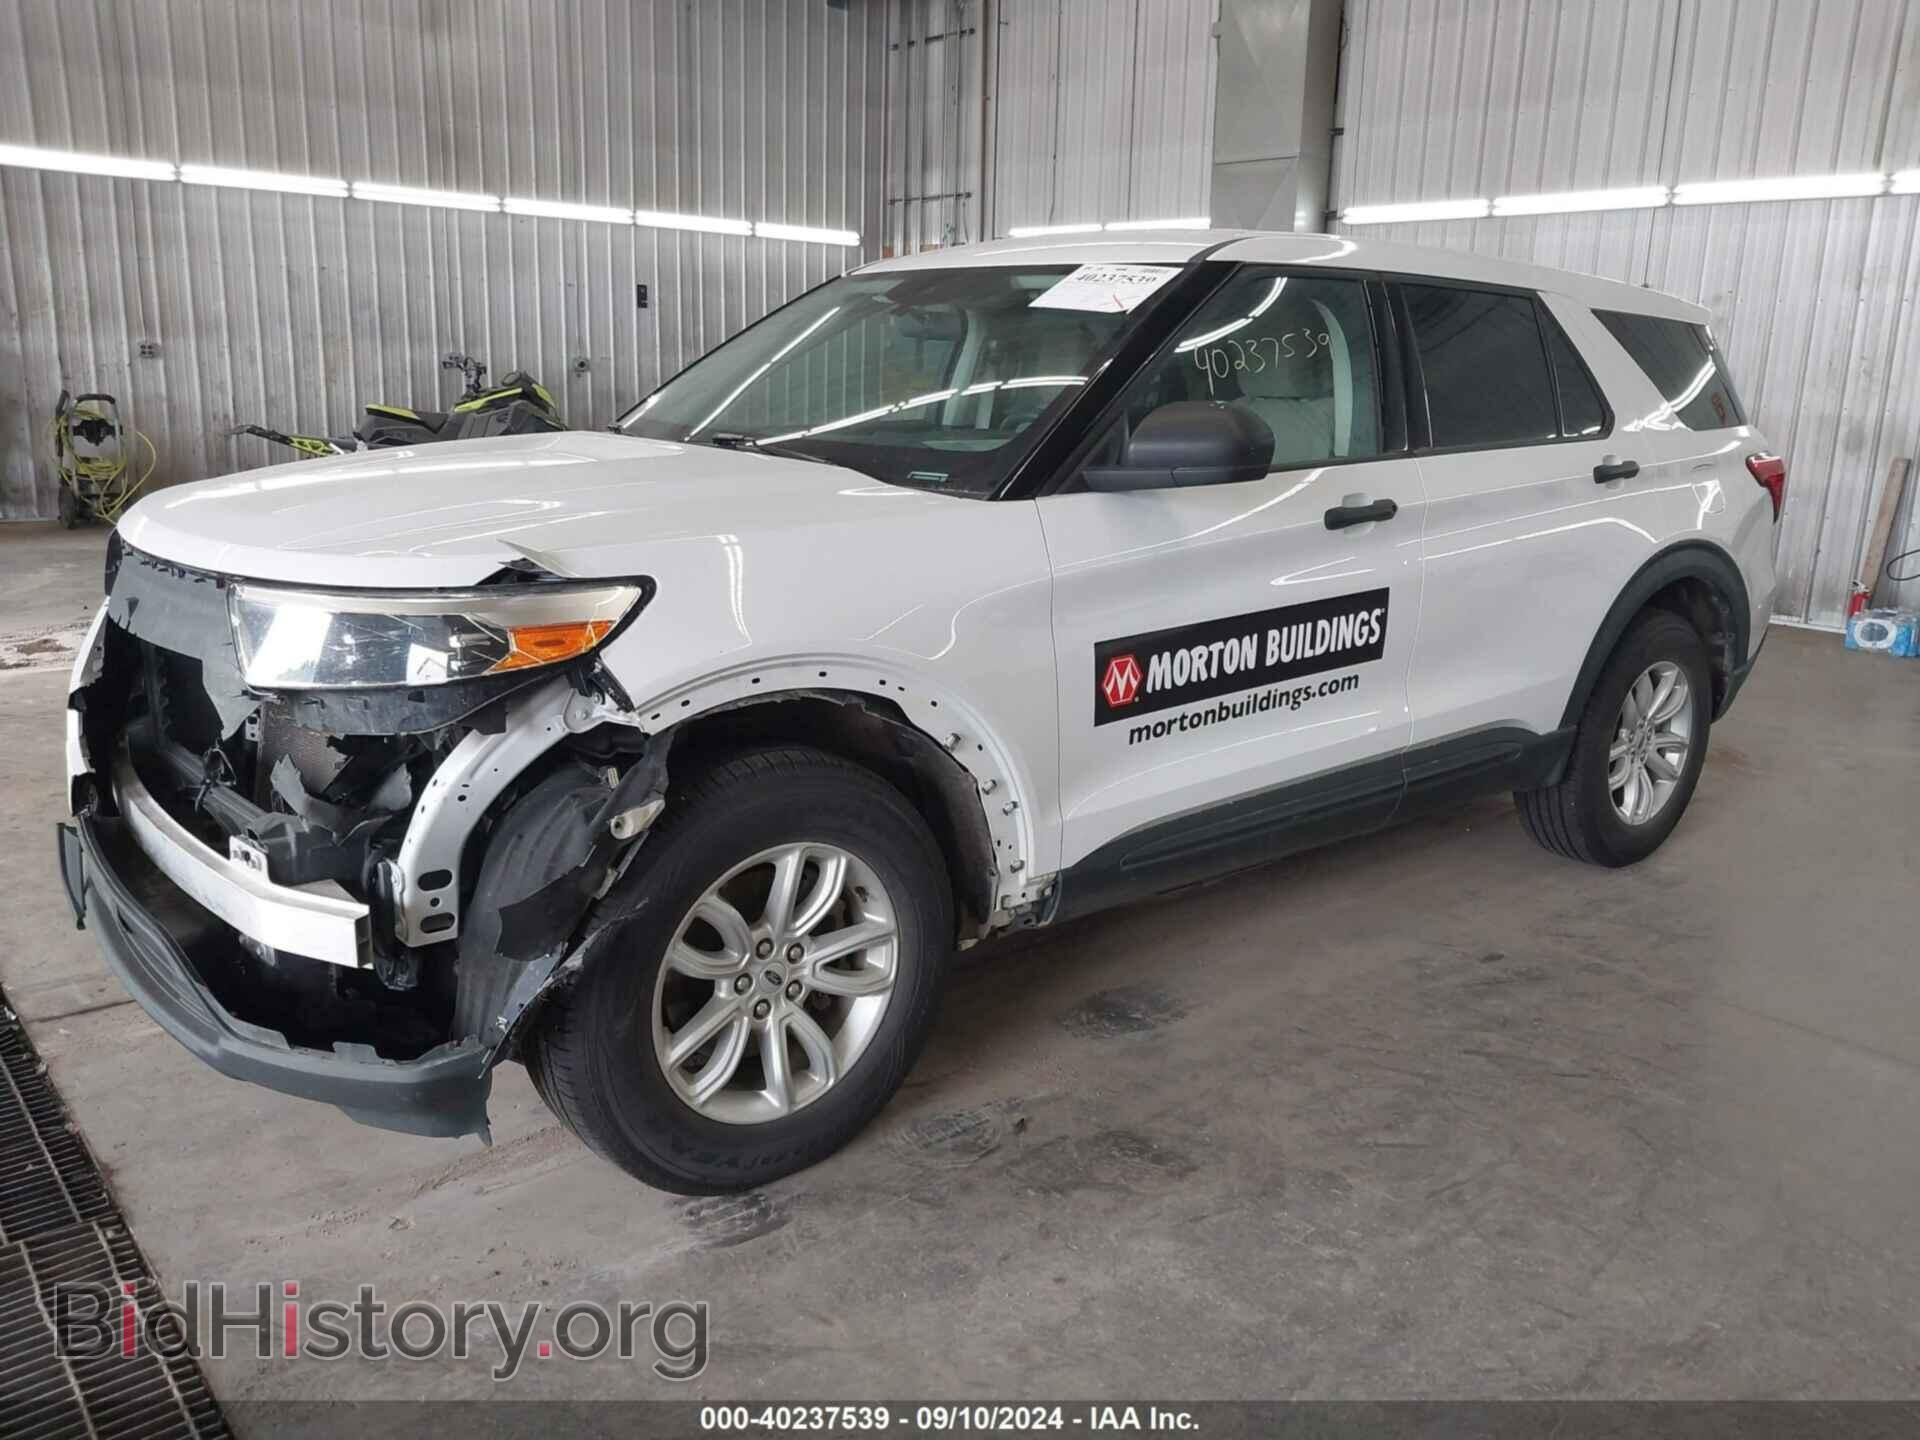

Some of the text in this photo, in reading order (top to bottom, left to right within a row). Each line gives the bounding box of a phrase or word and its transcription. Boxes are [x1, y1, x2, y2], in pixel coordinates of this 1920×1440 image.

[1146, 607, 1381, 694] MORTON BUILDINGS
[1128, 673, 1359, 745] mortonbuildings.com
